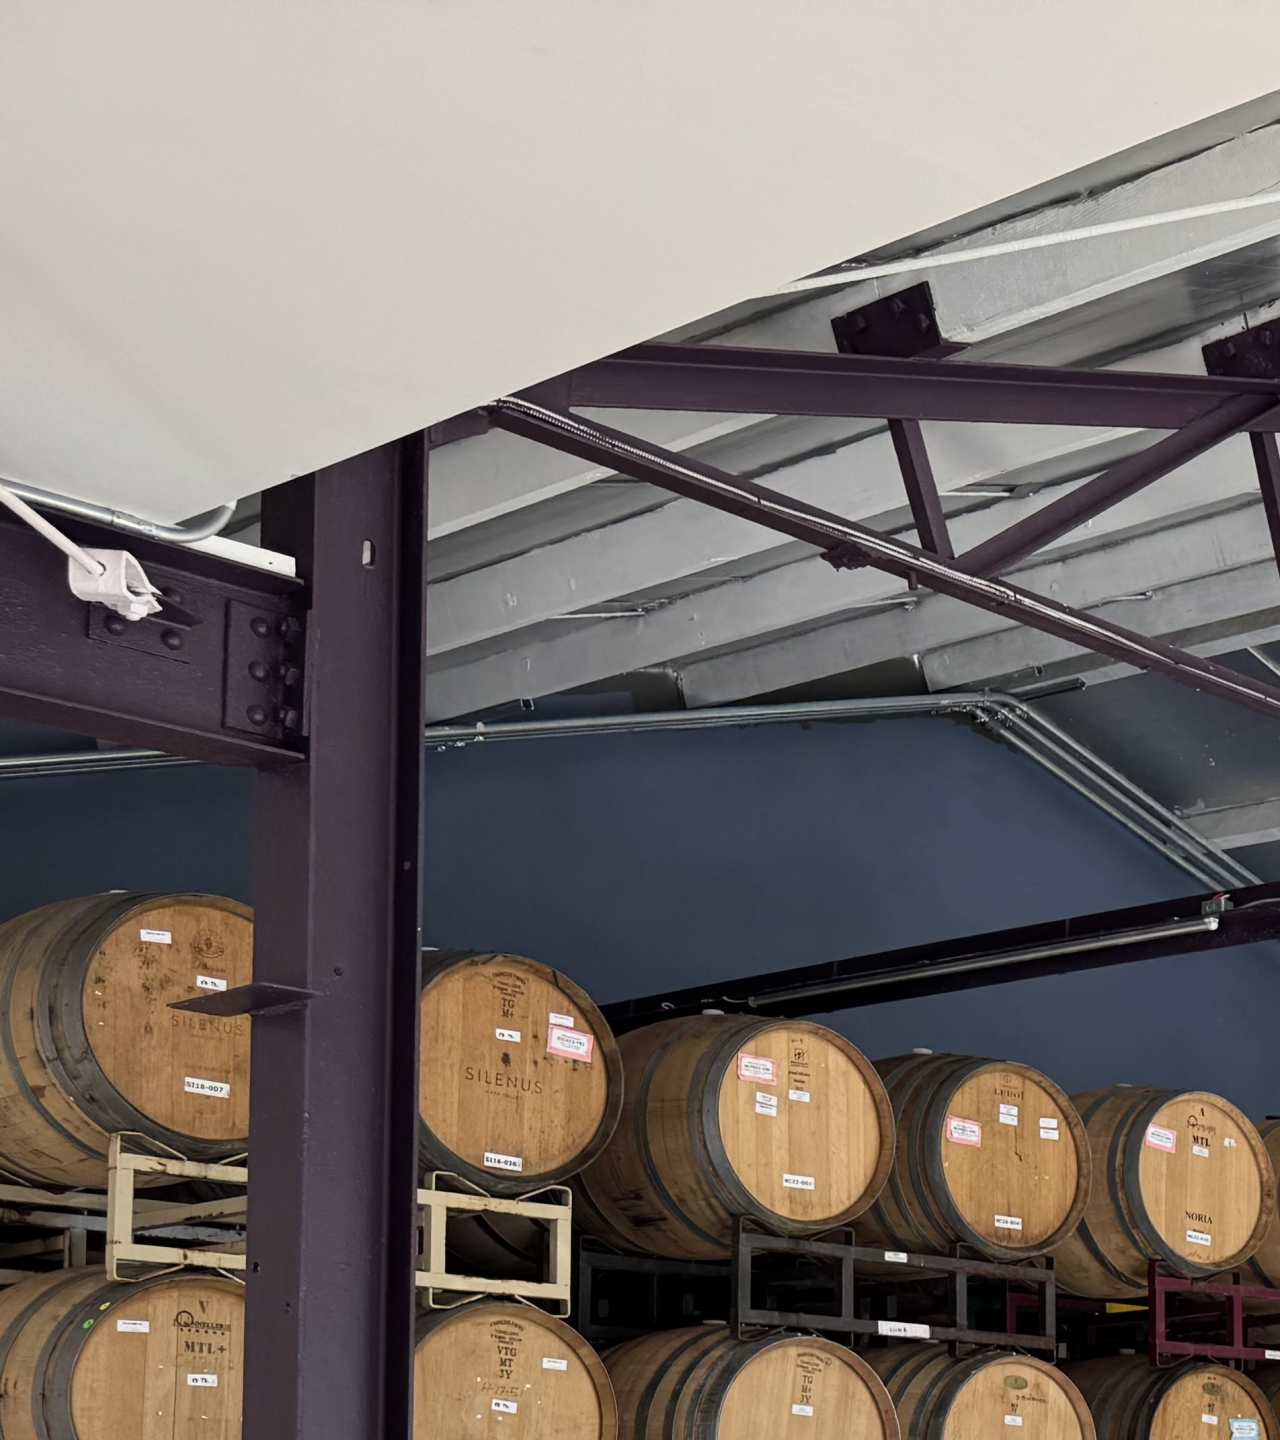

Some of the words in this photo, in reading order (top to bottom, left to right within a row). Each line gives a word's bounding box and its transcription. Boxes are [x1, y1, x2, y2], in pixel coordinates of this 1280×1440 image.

[171, 1014, 243, 1035] SILENUS
[465, 1066, 543, 1095] SILENUS
[1185, 1210, 1213, 1225] NORIA
